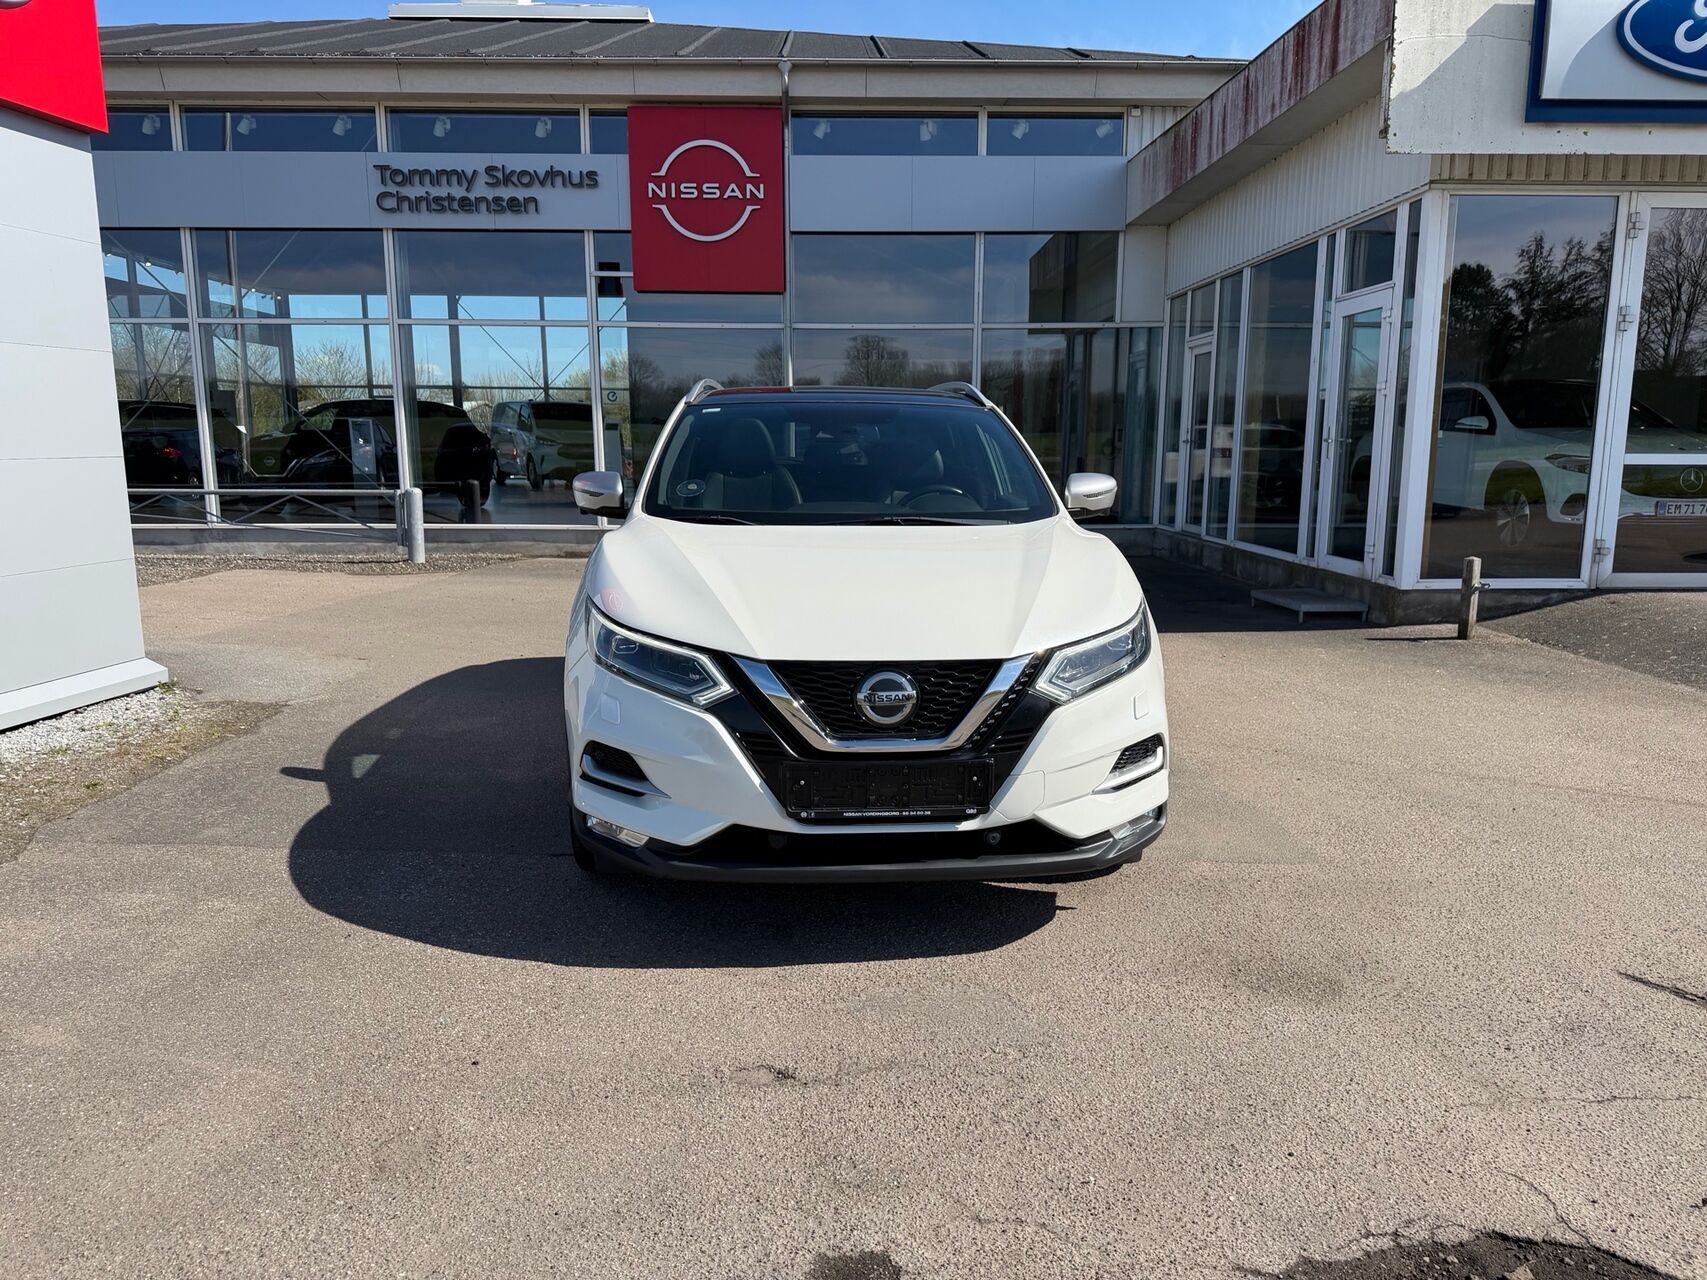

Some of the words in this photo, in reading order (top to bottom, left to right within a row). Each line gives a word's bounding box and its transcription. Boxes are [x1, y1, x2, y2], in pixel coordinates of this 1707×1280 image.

[373, 164, 478, 192] Tommy
[484, 164, 599, 188] Skovhus
[648, 182, 765, 199] NISSAN
[375, 190, 539, 215] Christensen
[1667, 504, 1682, 515] EM
[1684, 504, 1696, 515] 71
[1699, 504, 1707, 515] 7
[863, 691, 914, 703] NISSAN
